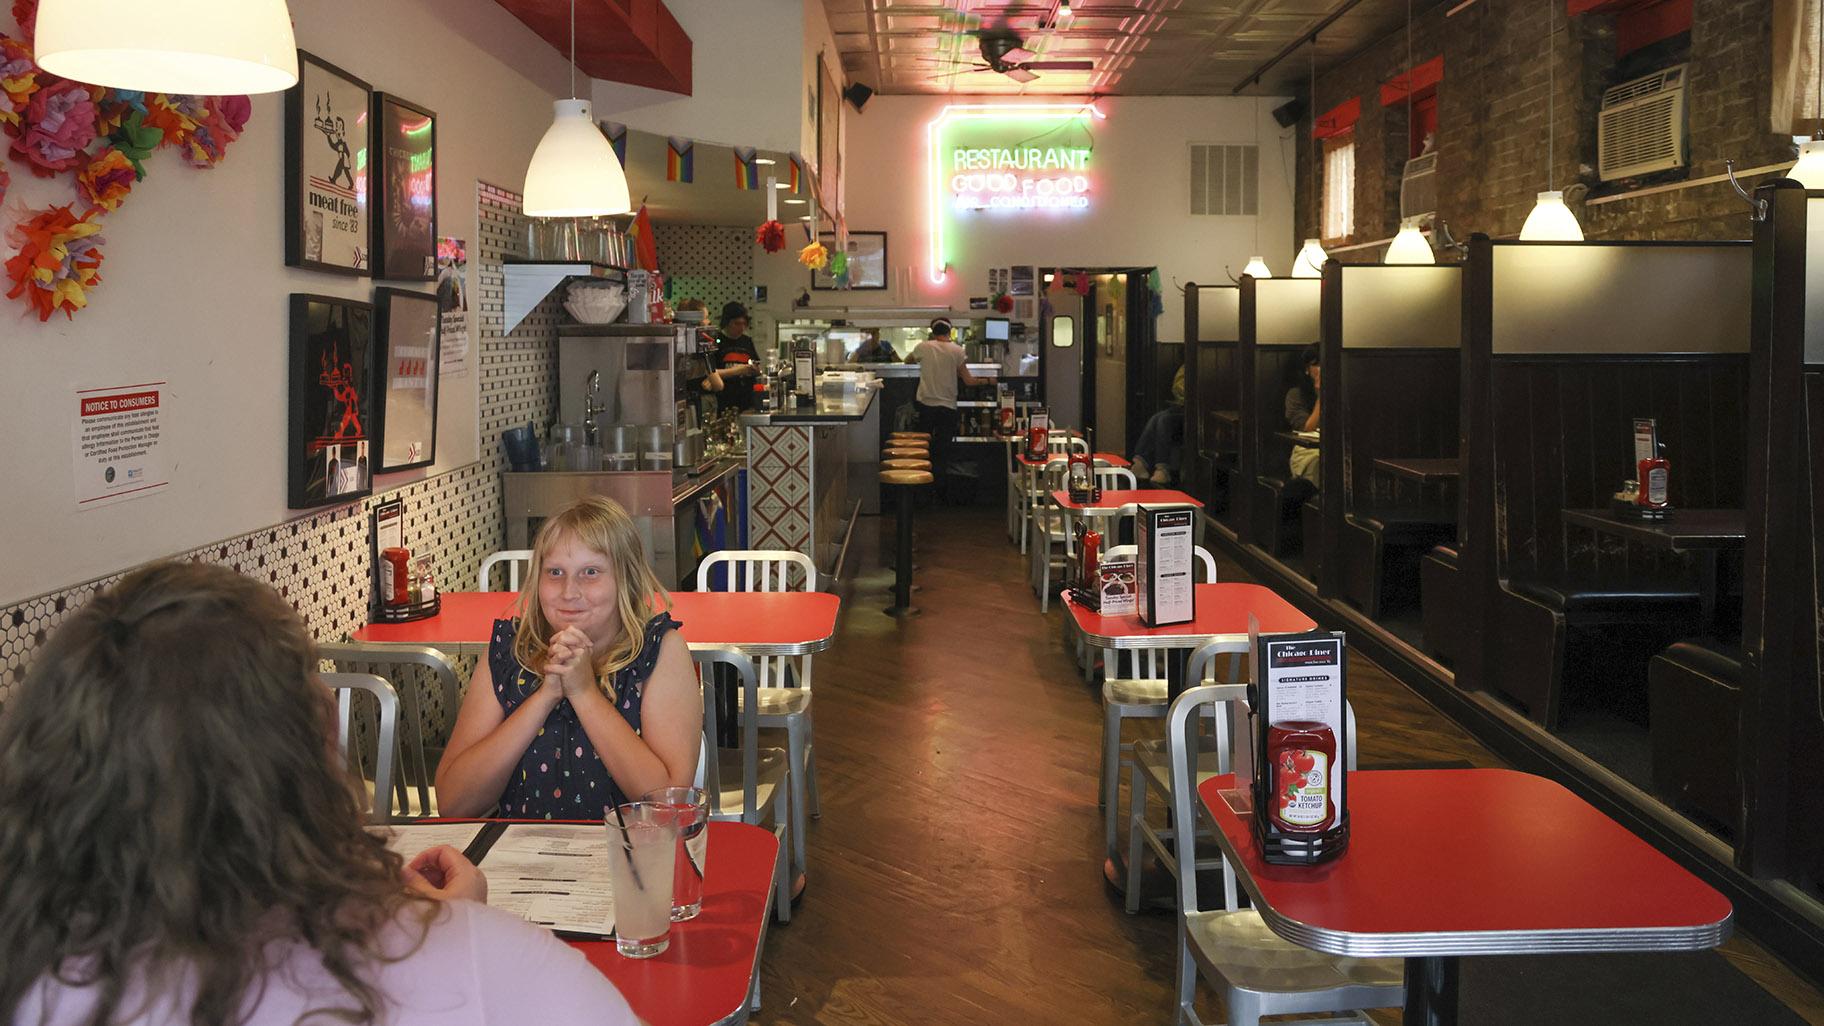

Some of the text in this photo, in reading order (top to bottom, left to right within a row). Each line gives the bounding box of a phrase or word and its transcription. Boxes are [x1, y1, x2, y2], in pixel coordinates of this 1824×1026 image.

[953, 148, 1090, 171] RESTAURANT
[951, 173, 1088, 197] GOOD FOOD
[309, 191, 358, 218] meat free
[332, 216, 359, 233] since '83
[85, 396, 155, 412] NOTICE TO CONSUMERS
[1277, 650, 1307, 658] Chicago
